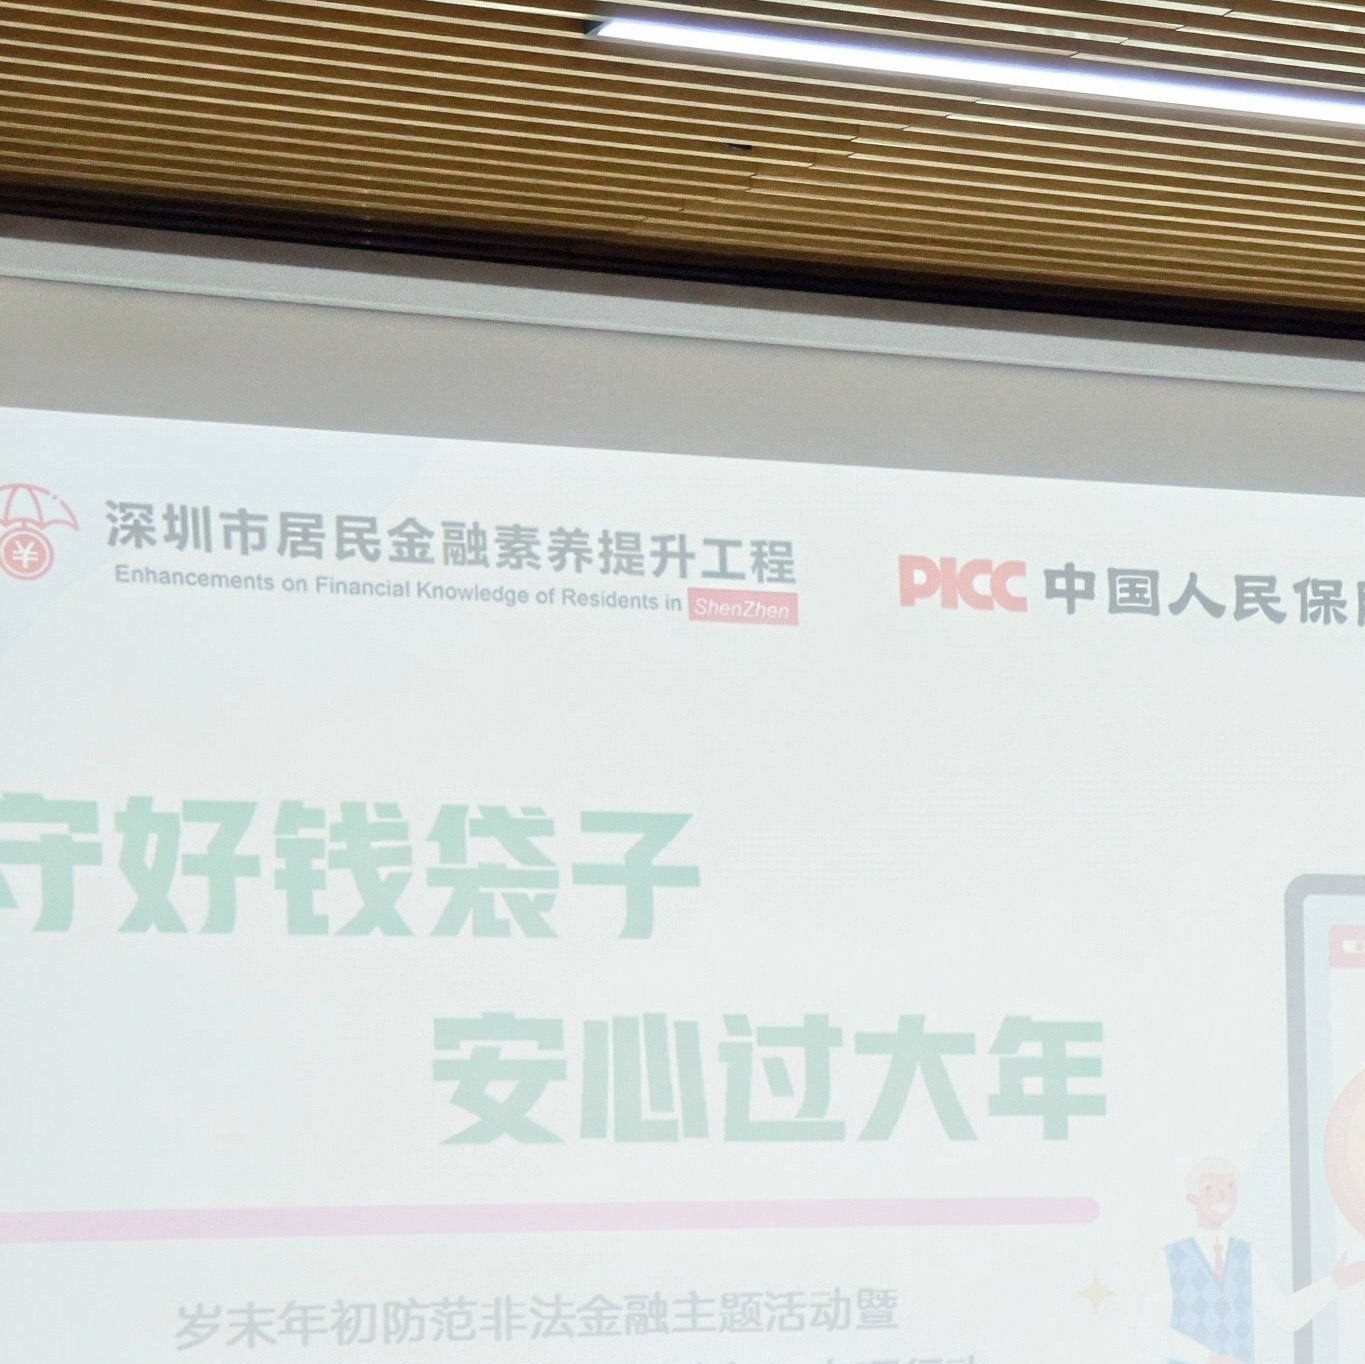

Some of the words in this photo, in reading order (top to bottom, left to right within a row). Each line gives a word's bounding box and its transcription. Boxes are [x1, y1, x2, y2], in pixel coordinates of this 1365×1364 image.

[105, 499, 796, 586] 深圳市居民金融素养提升工程
[115, 564, 275, 591] Enhancements
[282, 577, 307, 593] on
[316, 575, 410, 598] Financial
[417, 581, 529, 607] Knowledge
[536, 587, 556, 605] of
[562, 589, 658, 610] Residents
[665, 595, 682, 612] in
[694, 598, 790, 620] ShenZhen
[898, 554, 1027, 612] PICC
[0, 792, 700, 940] 守好钱袋子
[432, 1011, 1106, 1146] 安心过大年
[175, 1287, 898, 1351] 岁末年初防范非法金融主题活动暨
